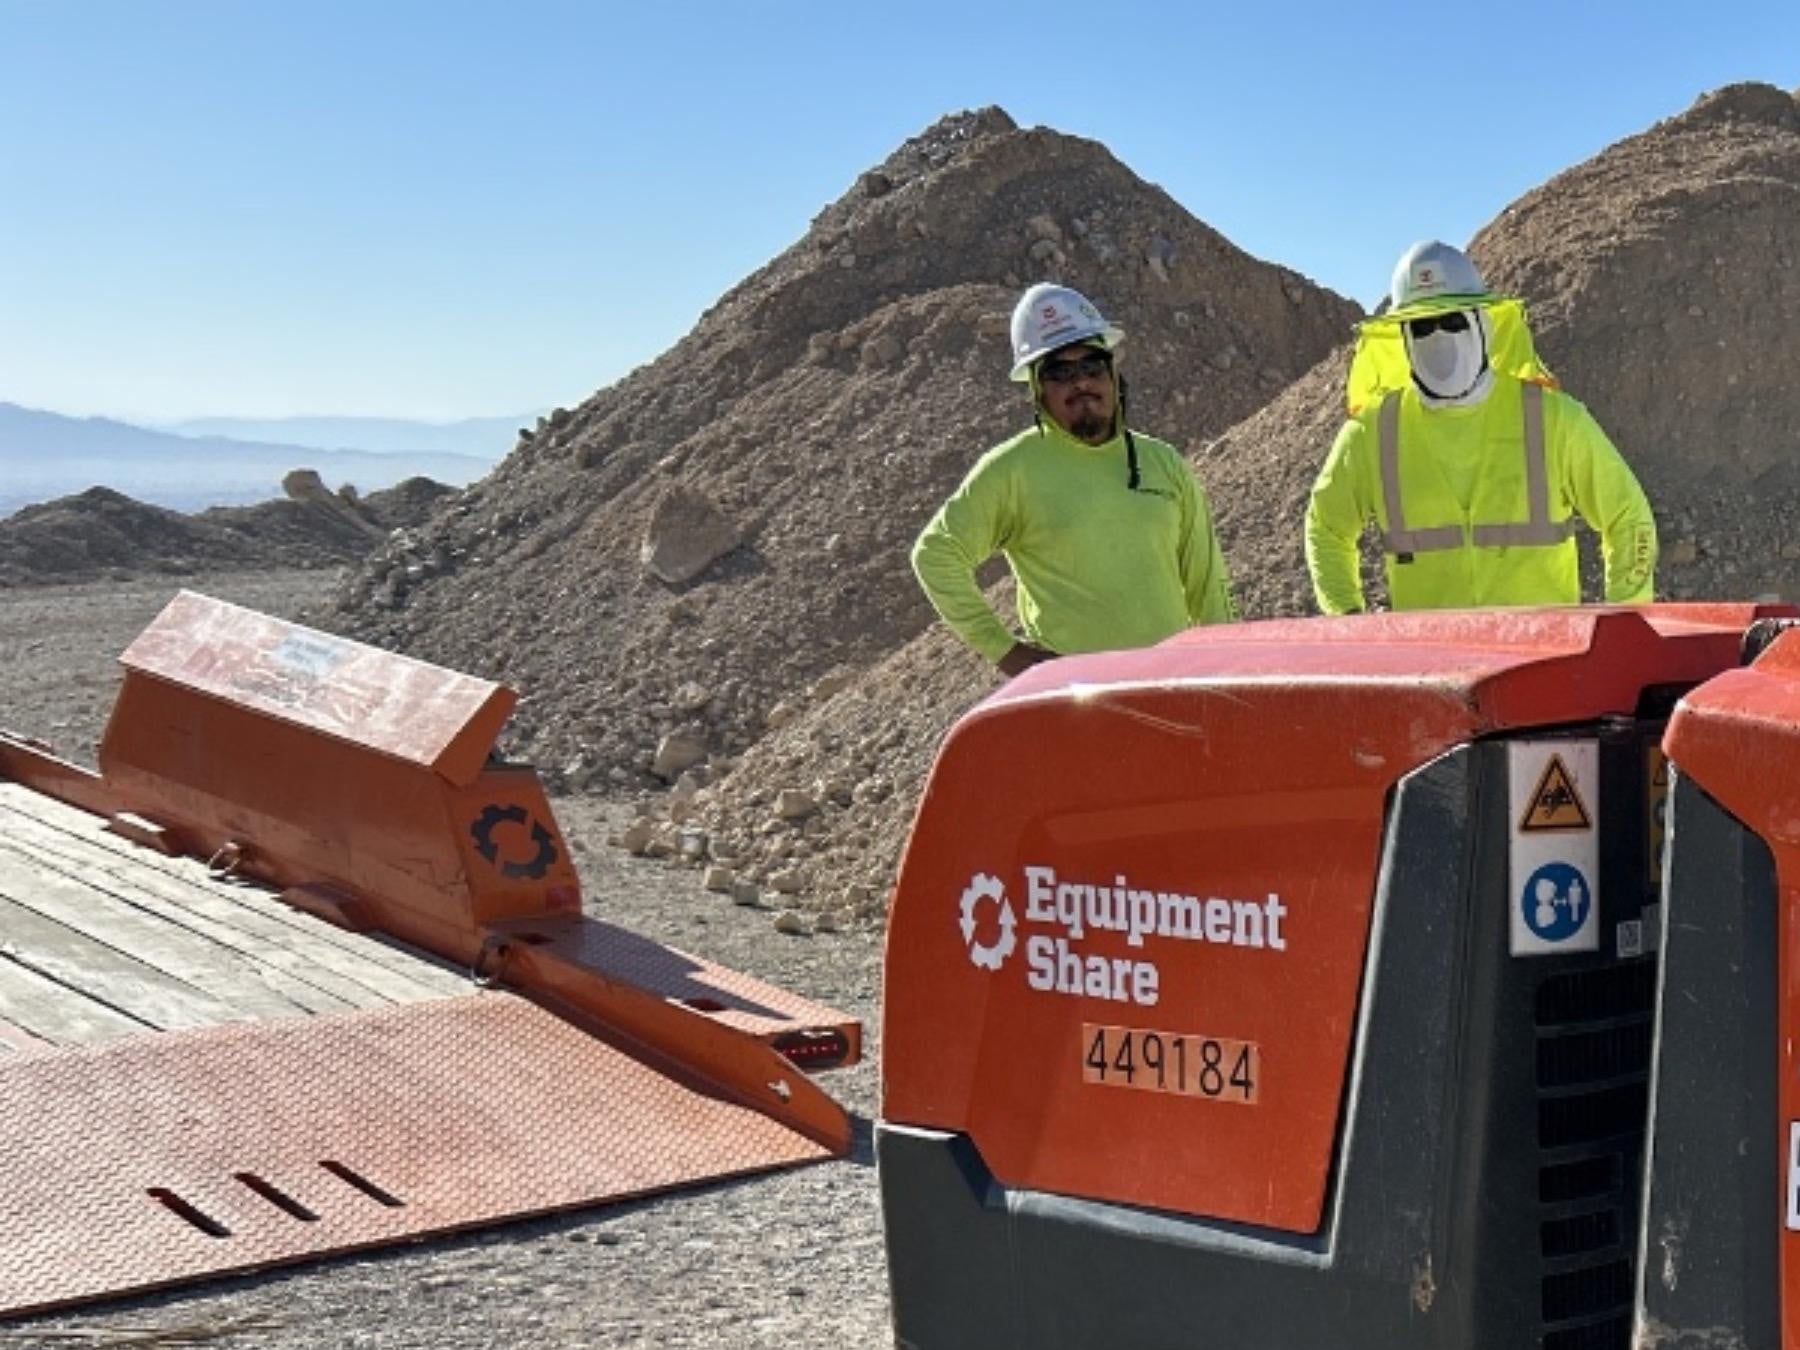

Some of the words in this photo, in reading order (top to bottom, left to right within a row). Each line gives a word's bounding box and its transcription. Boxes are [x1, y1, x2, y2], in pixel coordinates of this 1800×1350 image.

[1023, 865, 1288, 953] Equipment
[1026, 934, 1160, 1007] Share
[1086, 1028, 1255, 1100] 449184
